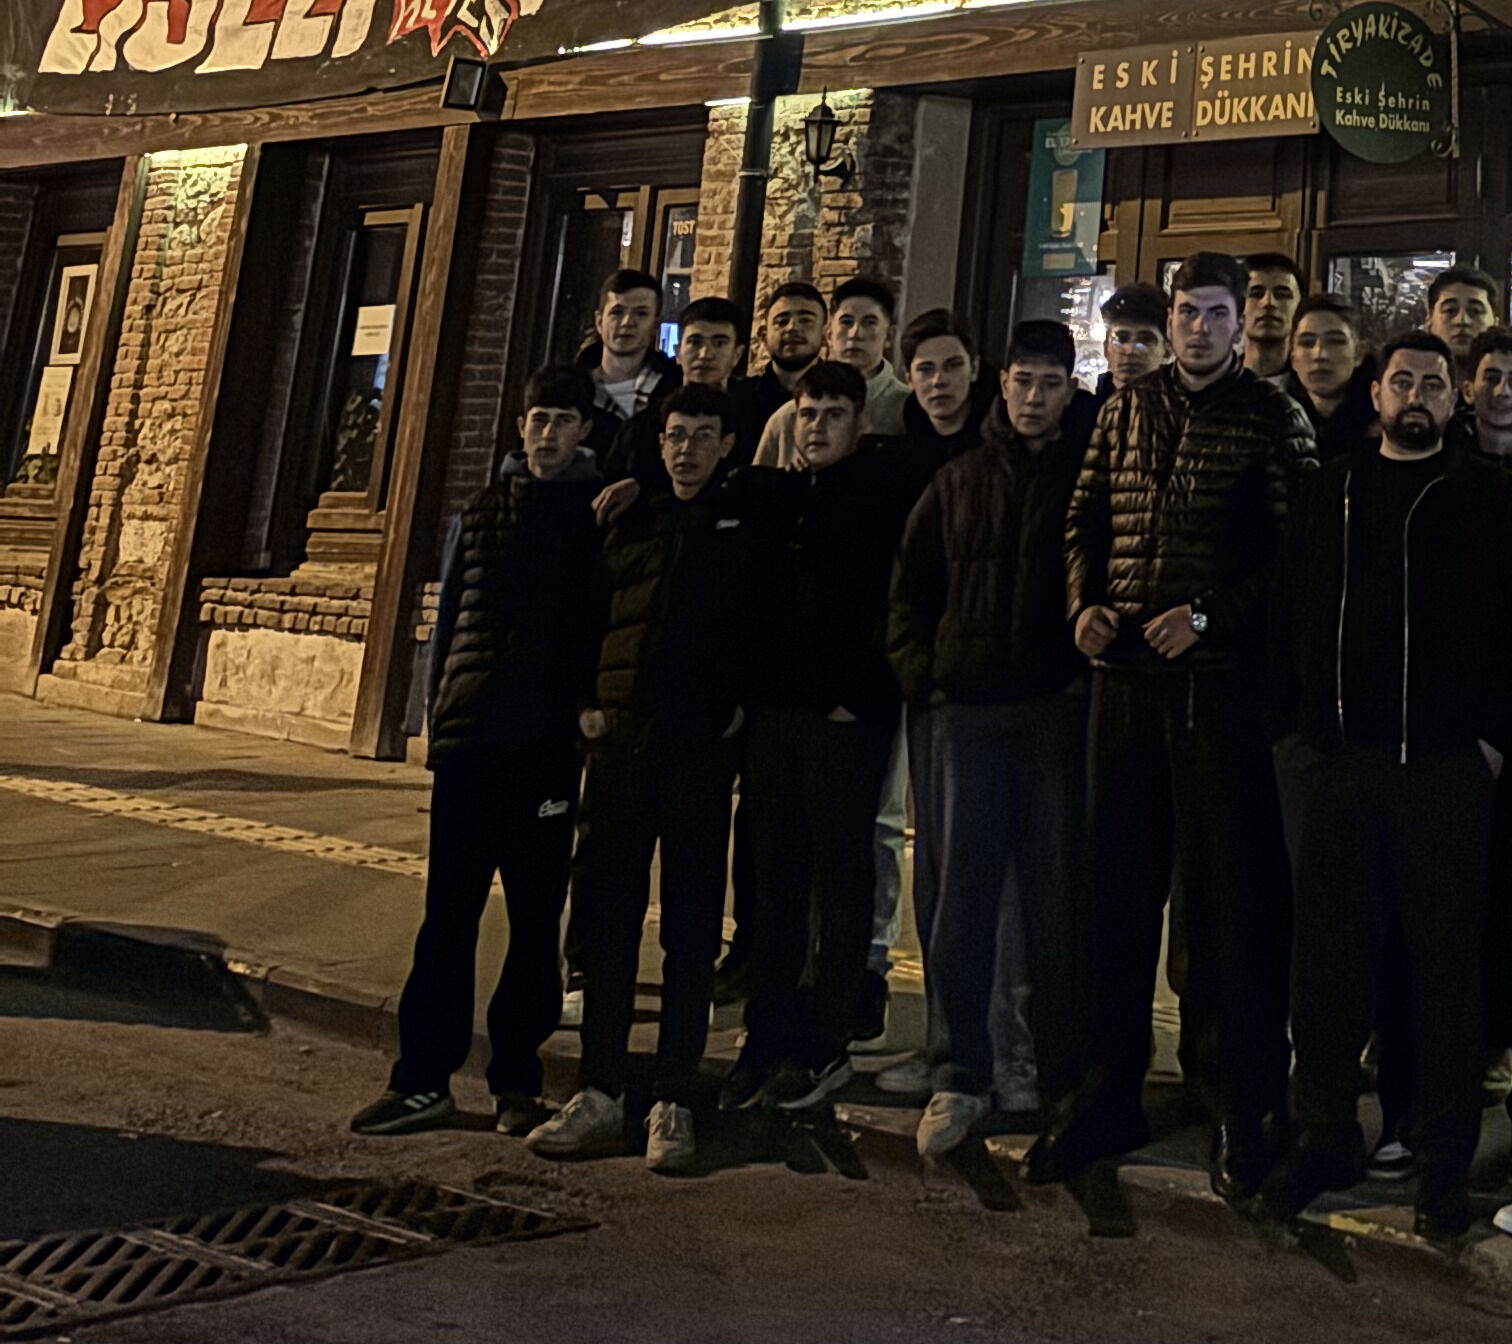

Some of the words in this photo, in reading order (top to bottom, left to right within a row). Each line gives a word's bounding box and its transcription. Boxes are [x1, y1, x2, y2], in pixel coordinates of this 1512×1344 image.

[1092, 49, 1179, 90] ESKİ
[1199, 39, 1316, 90] ŞEHRİN
[1320, 11, 1444, 89] TİRYAKİZADE
[1089, 101, 1174, 134] KAHVE
[1195, 89, 1315, 127] DÜKKANI
[1336, 86, 1370, 106] Eski
[1377, 89, 1430, 111] Şehrin
[1335, 109, 1376, 128] Kahve
[1379, 112, 1430, 133] Dükkanı
[672, 220, 696, 236] TOST
